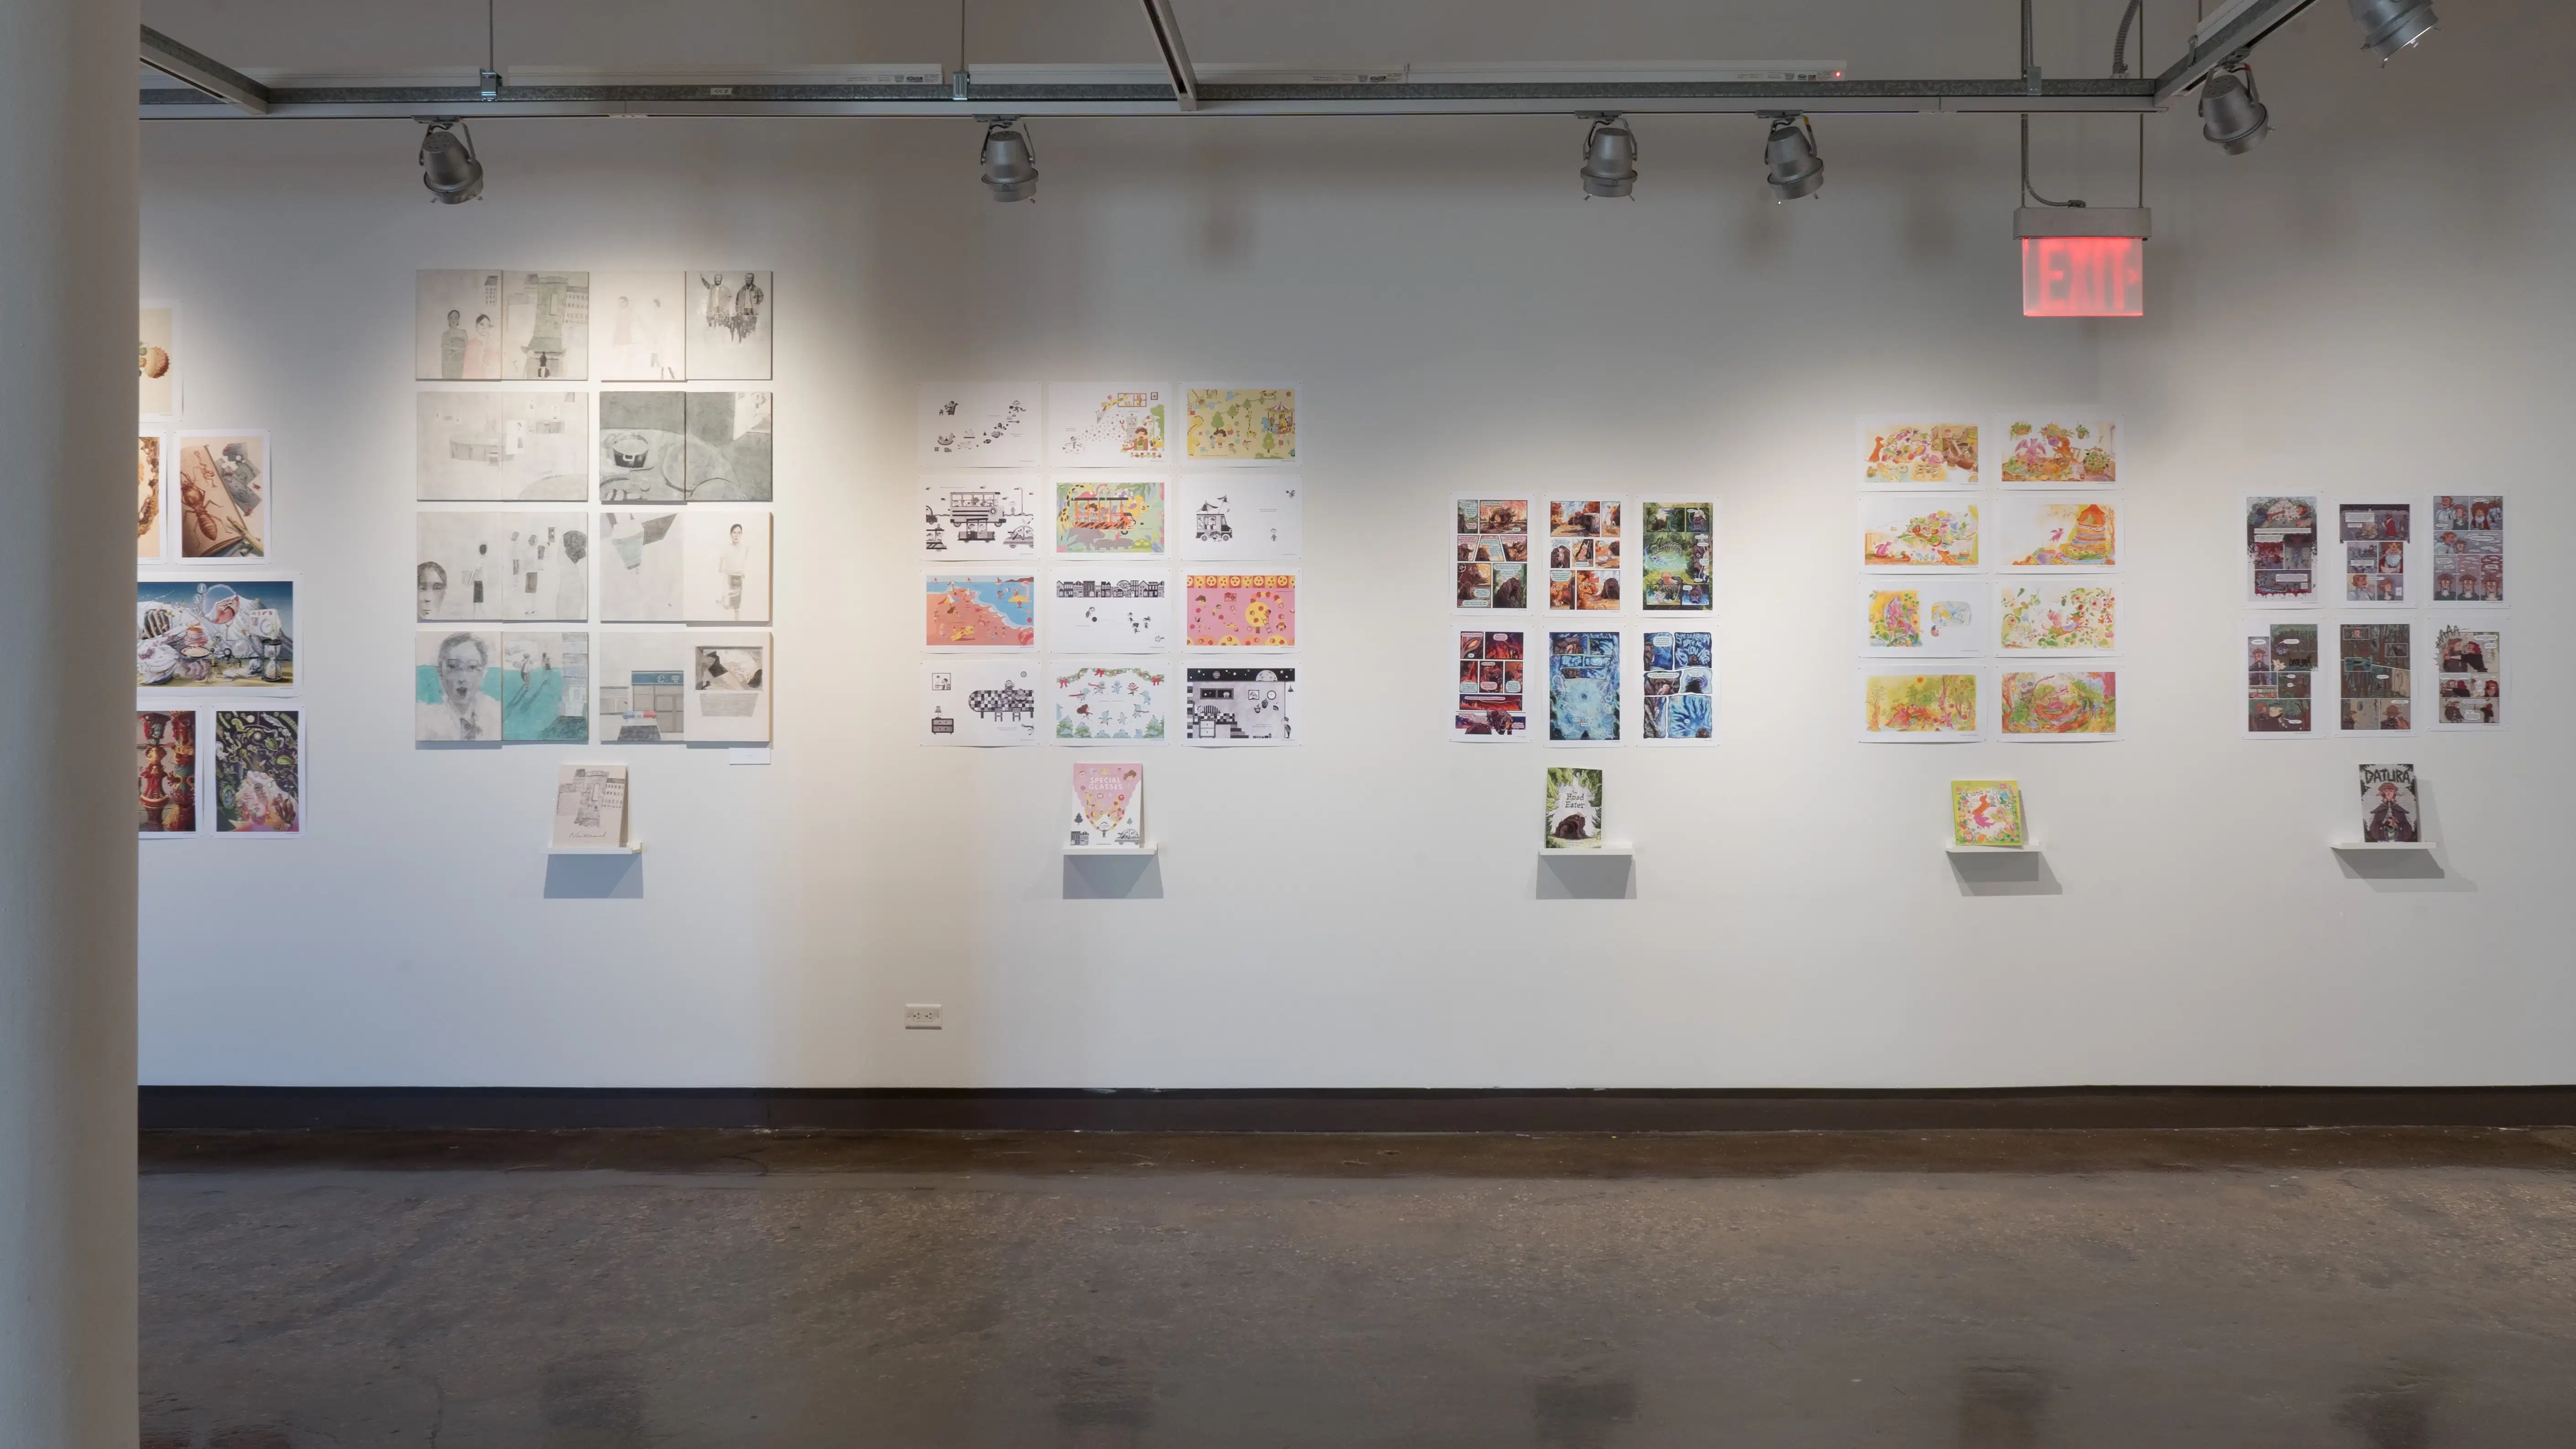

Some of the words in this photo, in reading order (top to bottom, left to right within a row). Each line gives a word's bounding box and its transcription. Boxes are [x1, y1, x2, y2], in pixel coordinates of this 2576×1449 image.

[2038, 238, 2130, 311] EXIT
[2364, 768, 2410, 784] DATURA
[1566, 793, 1584, 801] Road
